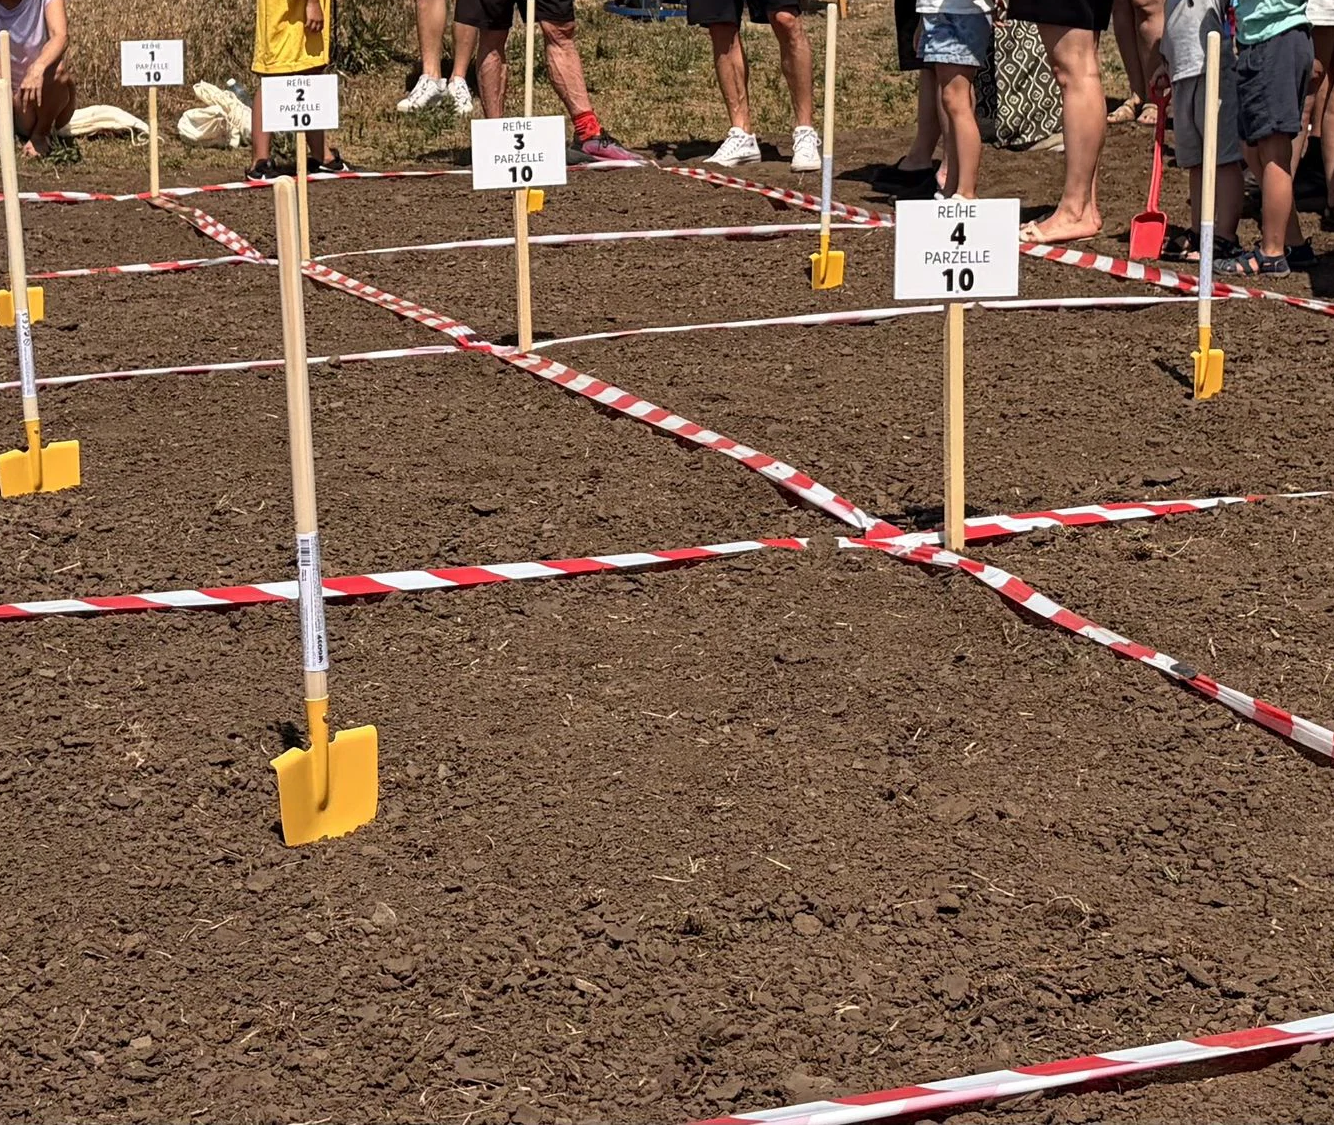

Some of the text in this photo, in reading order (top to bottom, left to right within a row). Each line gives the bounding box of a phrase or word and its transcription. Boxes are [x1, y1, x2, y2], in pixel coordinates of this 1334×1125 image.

[296, 88, 305, 102] 2
[291, 113, 311, 127] 10
[503, 120, 533, 131] REIHE
[514, 133, 525, 150] 3
[494, 152, 545, 164] PARZELLE
[508, 165, 534, 183] 10
[938, 204, 976, 219] REIHE
[950, 222, 966, 246] 4
[924, 250, 990, 265] PARZELLE
[942, 268, 974, 292] 10
